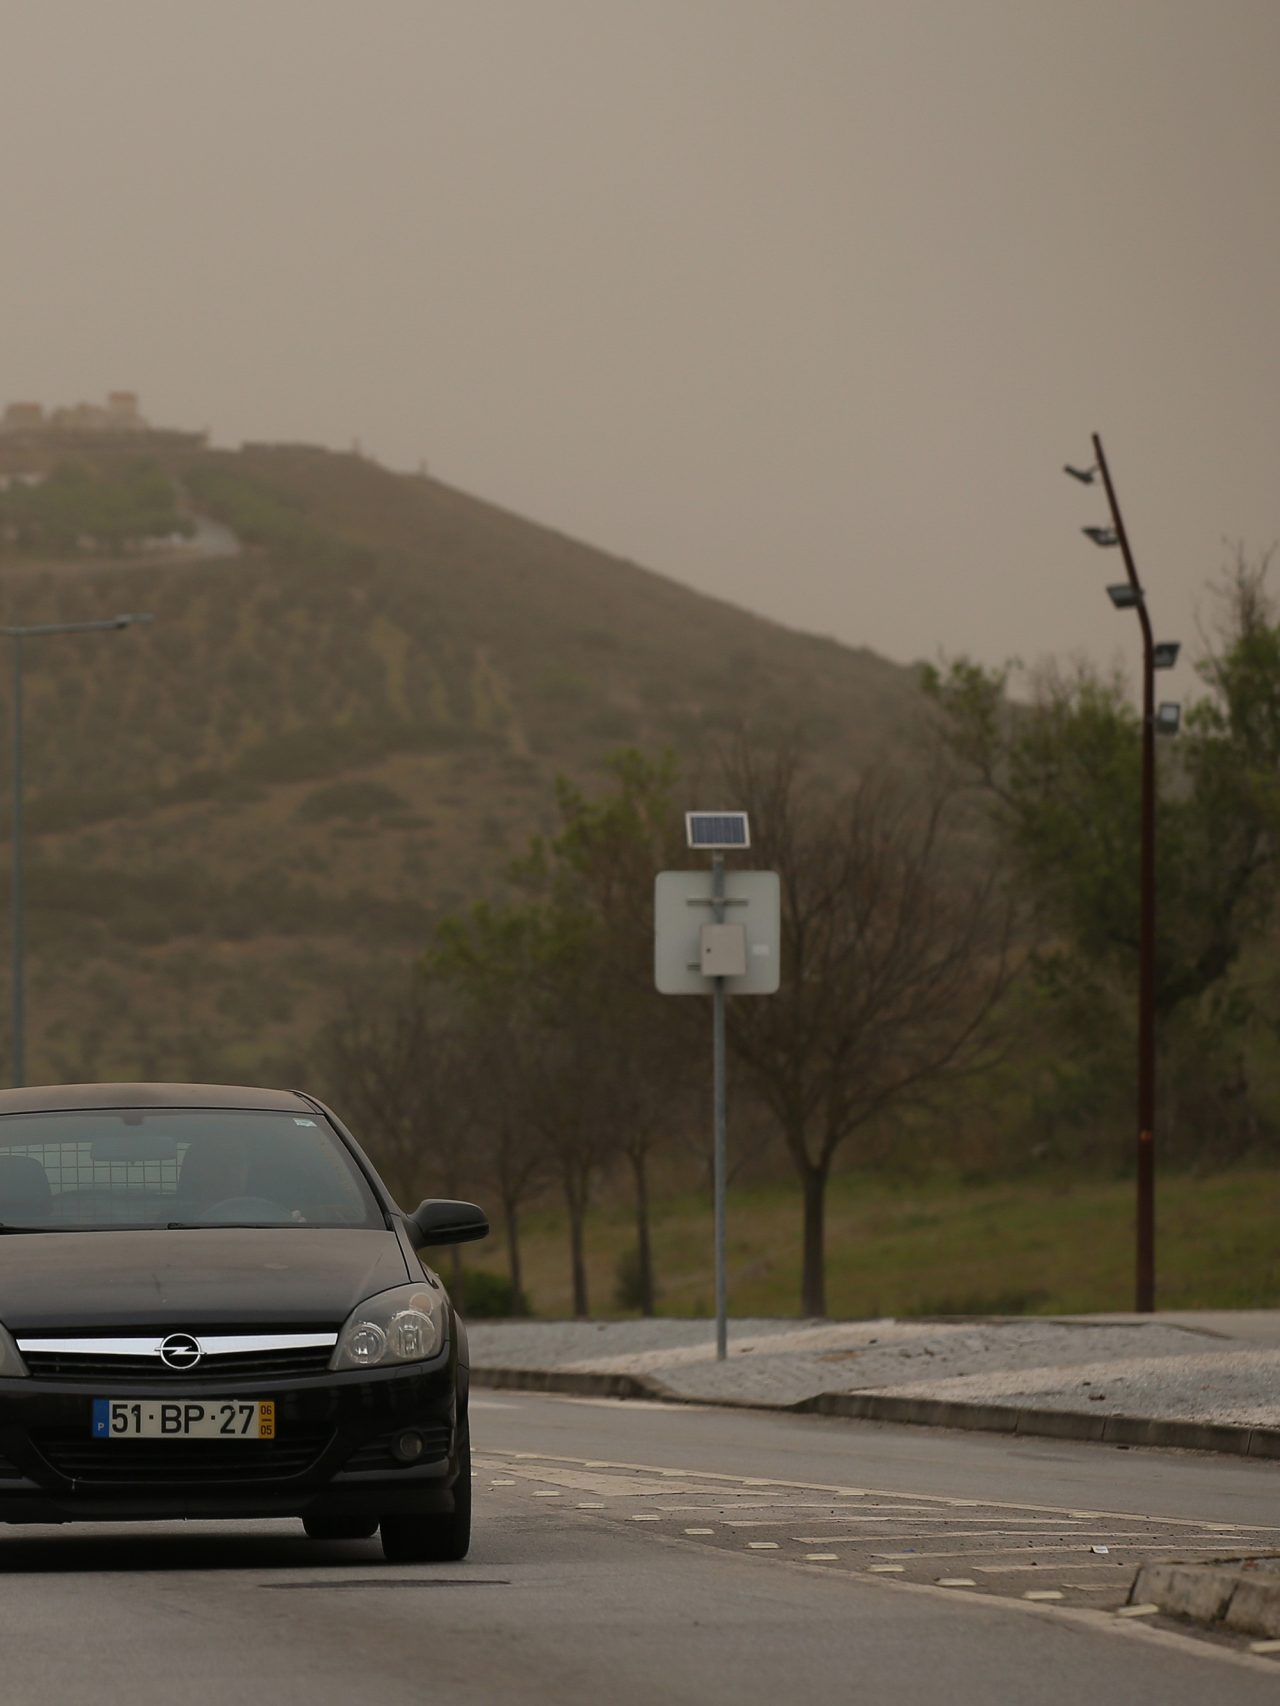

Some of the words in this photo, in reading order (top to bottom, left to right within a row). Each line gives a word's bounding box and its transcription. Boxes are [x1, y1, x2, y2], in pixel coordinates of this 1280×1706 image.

[260, 1404, 272, 1415] 06
[97, 1422, 105, 1432] P
[260, 1424, 272, 1435] 05
